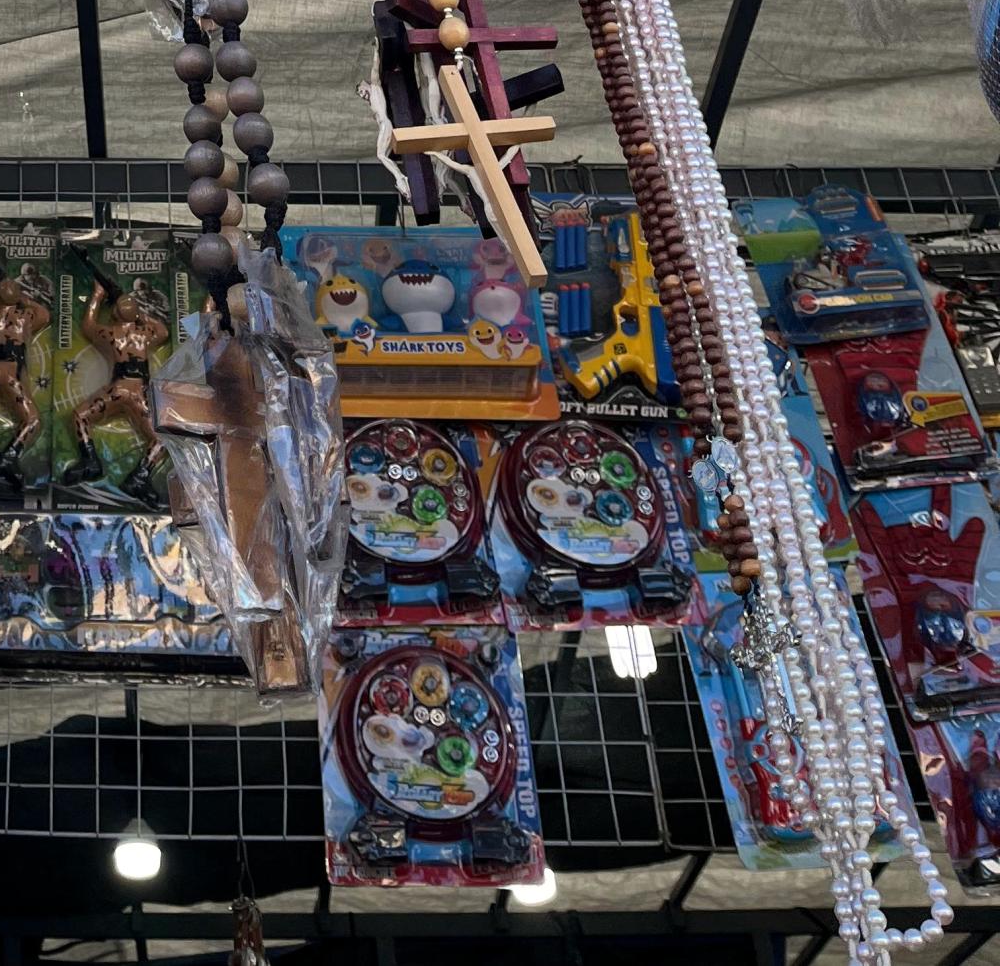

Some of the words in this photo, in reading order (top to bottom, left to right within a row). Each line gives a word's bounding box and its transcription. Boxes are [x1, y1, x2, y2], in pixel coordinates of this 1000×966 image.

[9, 247, 47, 256] FORCE
[106, 250, 167, 260] MILITARY
[119, 261, 159, 271] FORCE
[60, 275, 73, 313] OPERATED
[59, 315, 71, 348] BATTERY
[382, 340, 425, 352] SHARK
[426, 342, 465, 353] TOYS
[560, 402, 583, 413] OFT
[587, 403, 638, 416] BULLET
[641, 406, 668, 418] GUN
[652, 468, 680, 522] SPEED
[666, 527, 690, 564] TOP
[508, 706, 529, 770] SPEED
[517, 778, 536, 819] TOP
